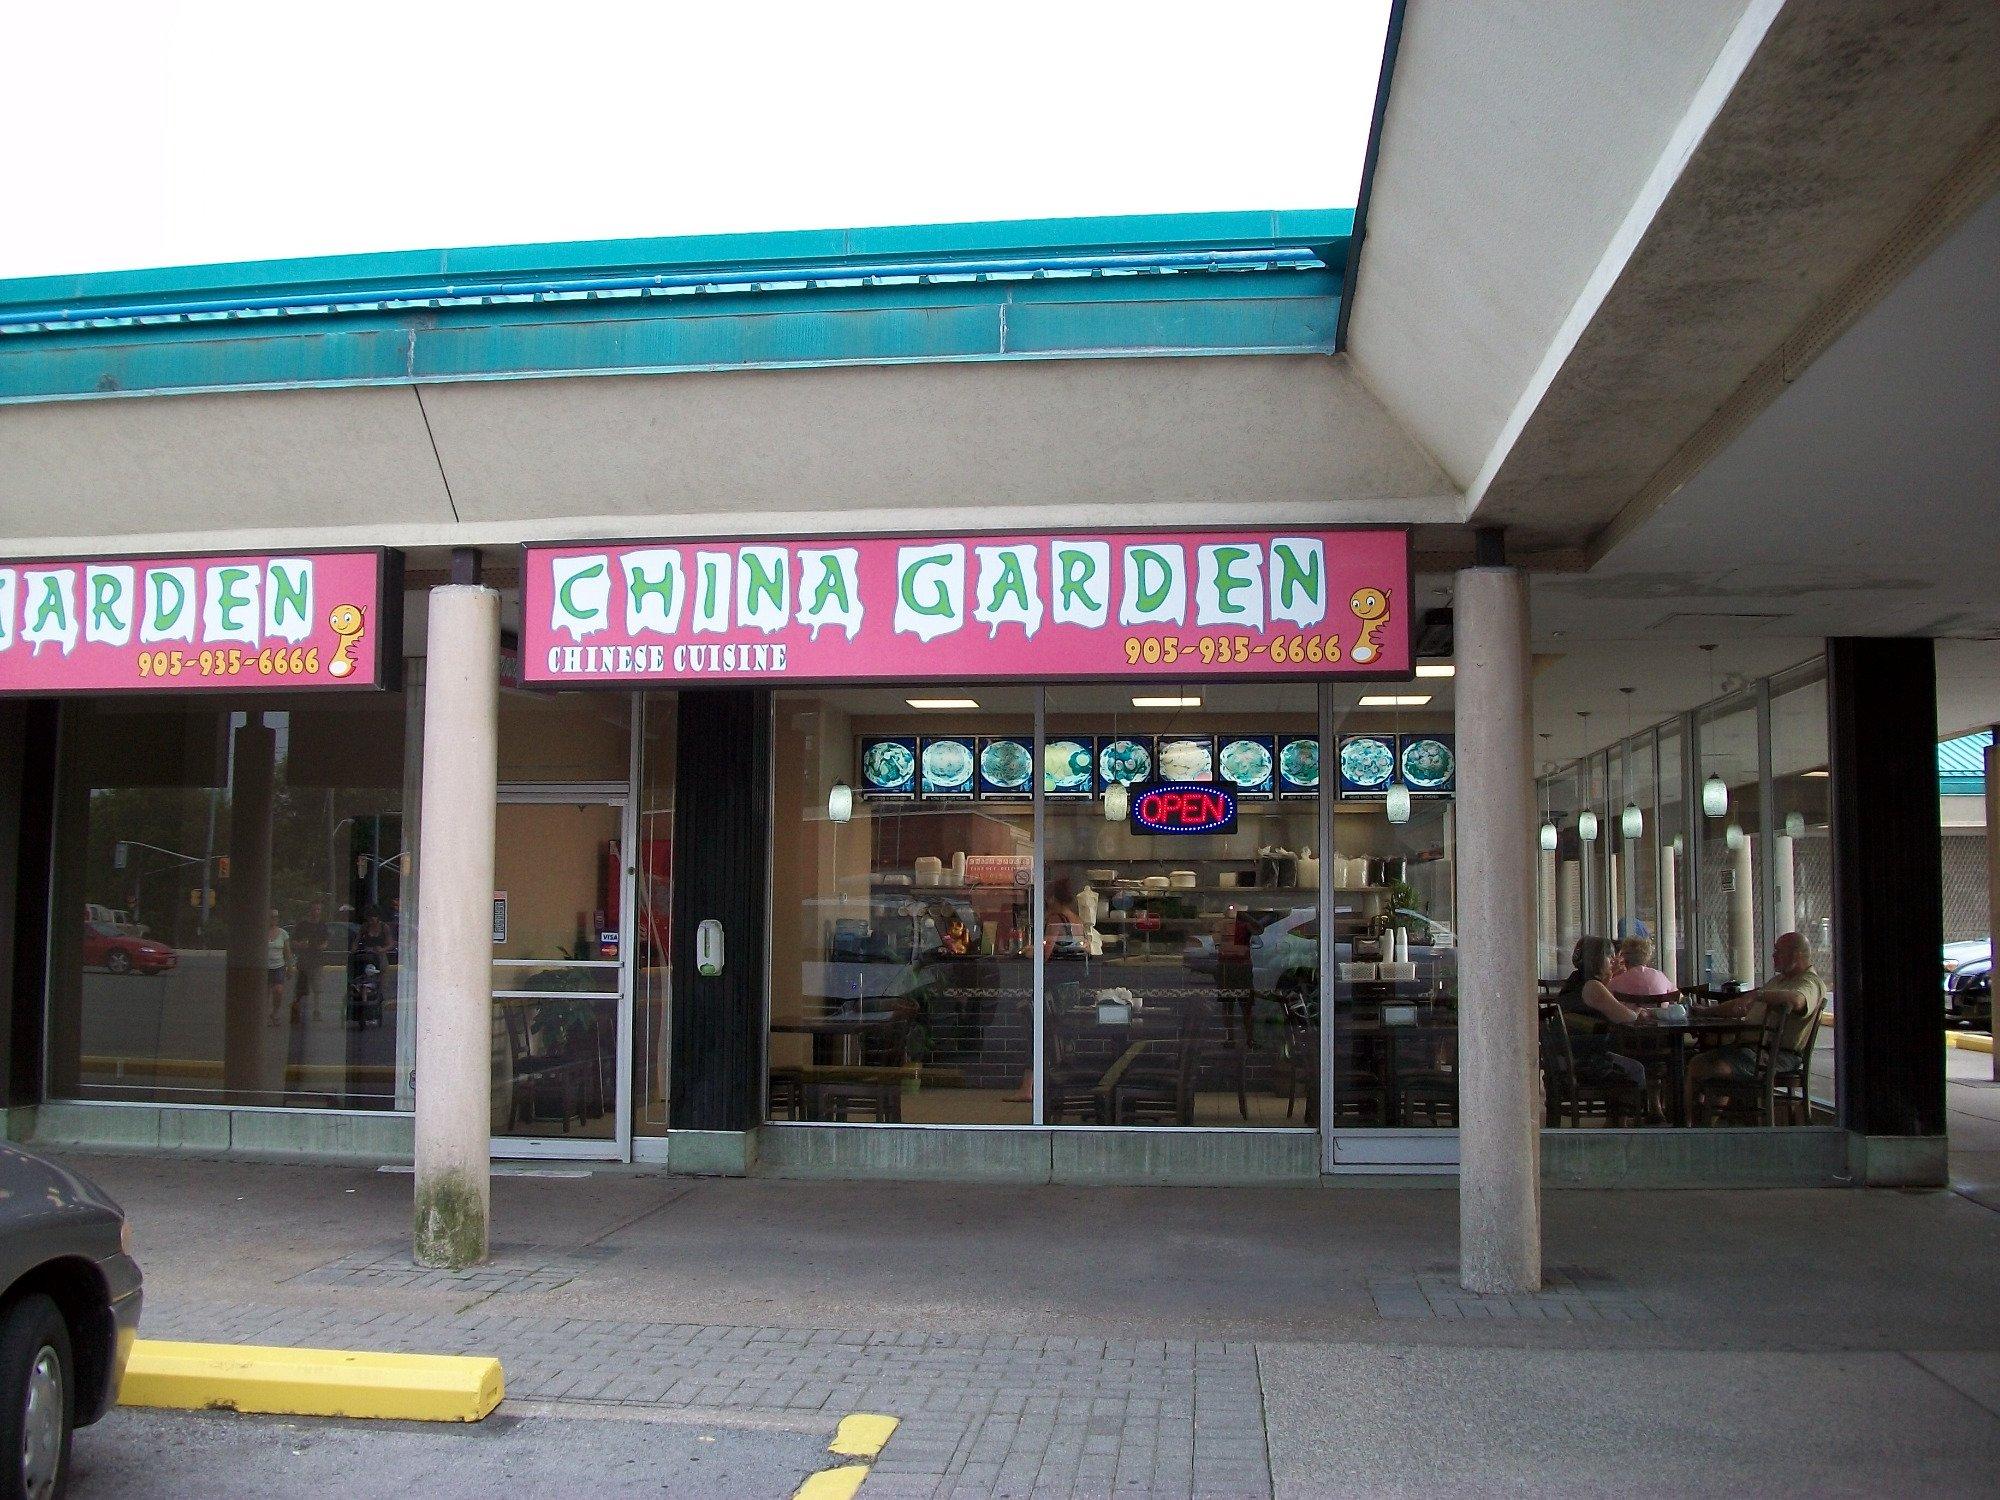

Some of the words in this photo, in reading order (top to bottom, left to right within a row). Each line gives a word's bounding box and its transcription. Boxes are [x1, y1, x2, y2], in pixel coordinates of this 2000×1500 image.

[558, 550, 851, 620] CHINA
[901, 544, 1324, 618] GARDEN
[0, 564, 309, 638] ARDEN
[137, 647, 320, 677] 905-935-6666
[547, 645, 665, 674] CHINESE
[673, 643, 788, 673] CUISINE
[1124, 634, 1342, 665] 905-935-6666
[1141, 792, 1226, 823] OPEN
